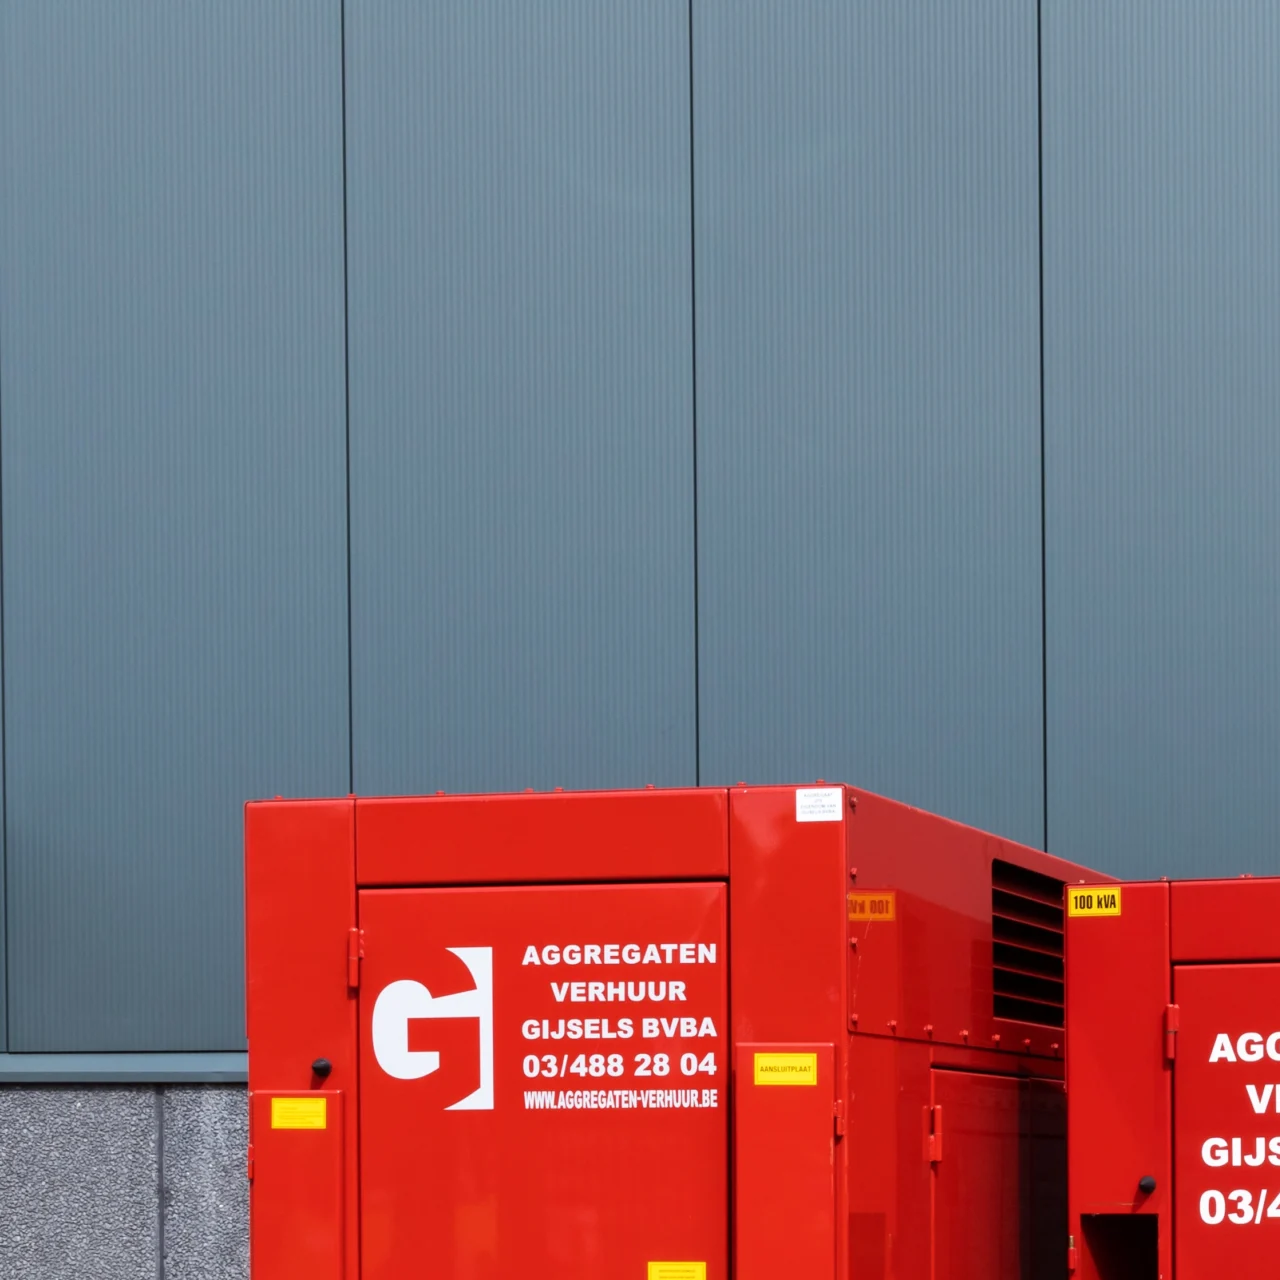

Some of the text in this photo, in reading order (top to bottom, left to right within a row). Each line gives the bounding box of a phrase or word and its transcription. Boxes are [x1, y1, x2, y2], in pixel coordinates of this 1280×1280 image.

[1074, 894, 1117, 910] 100 kVA
[521, 943, 718, 966] AGGREGATEN
[550, 980, 687, 1003] VERHUUR
[521, 1017, 718, 1040] GIJSELS BVBA
[522, 1052, 718, 1078] 03/488 28 04
[760, 1065, 811, 1073] AANSLUITPLAAT
[523, 1088, 718, 1110] WWW.AGGREGATEN-VERHUUR.BE
